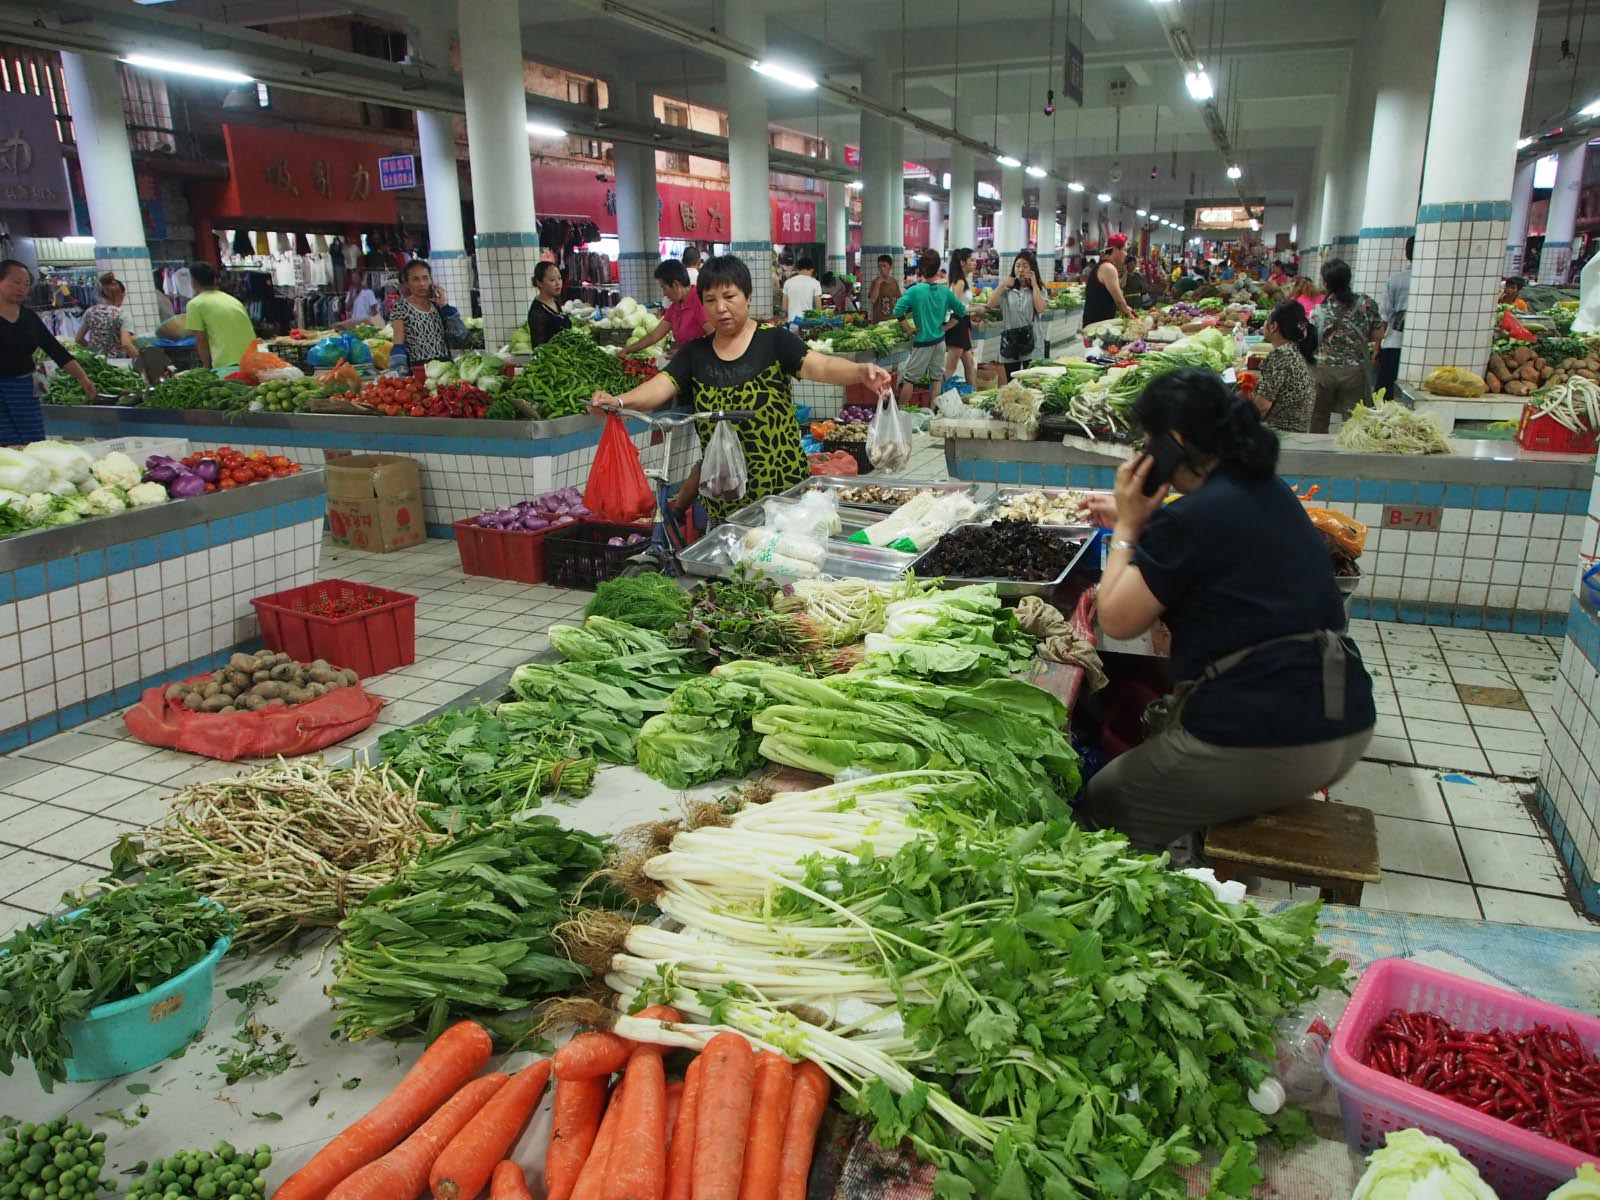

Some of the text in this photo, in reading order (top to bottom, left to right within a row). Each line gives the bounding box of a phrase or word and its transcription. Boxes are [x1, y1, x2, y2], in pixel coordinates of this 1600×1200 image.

[266, 158, 370, 201] 吸引力
[782, 212, 811, 232] 知名度
[1389, 510, 1434, 528] B-71
